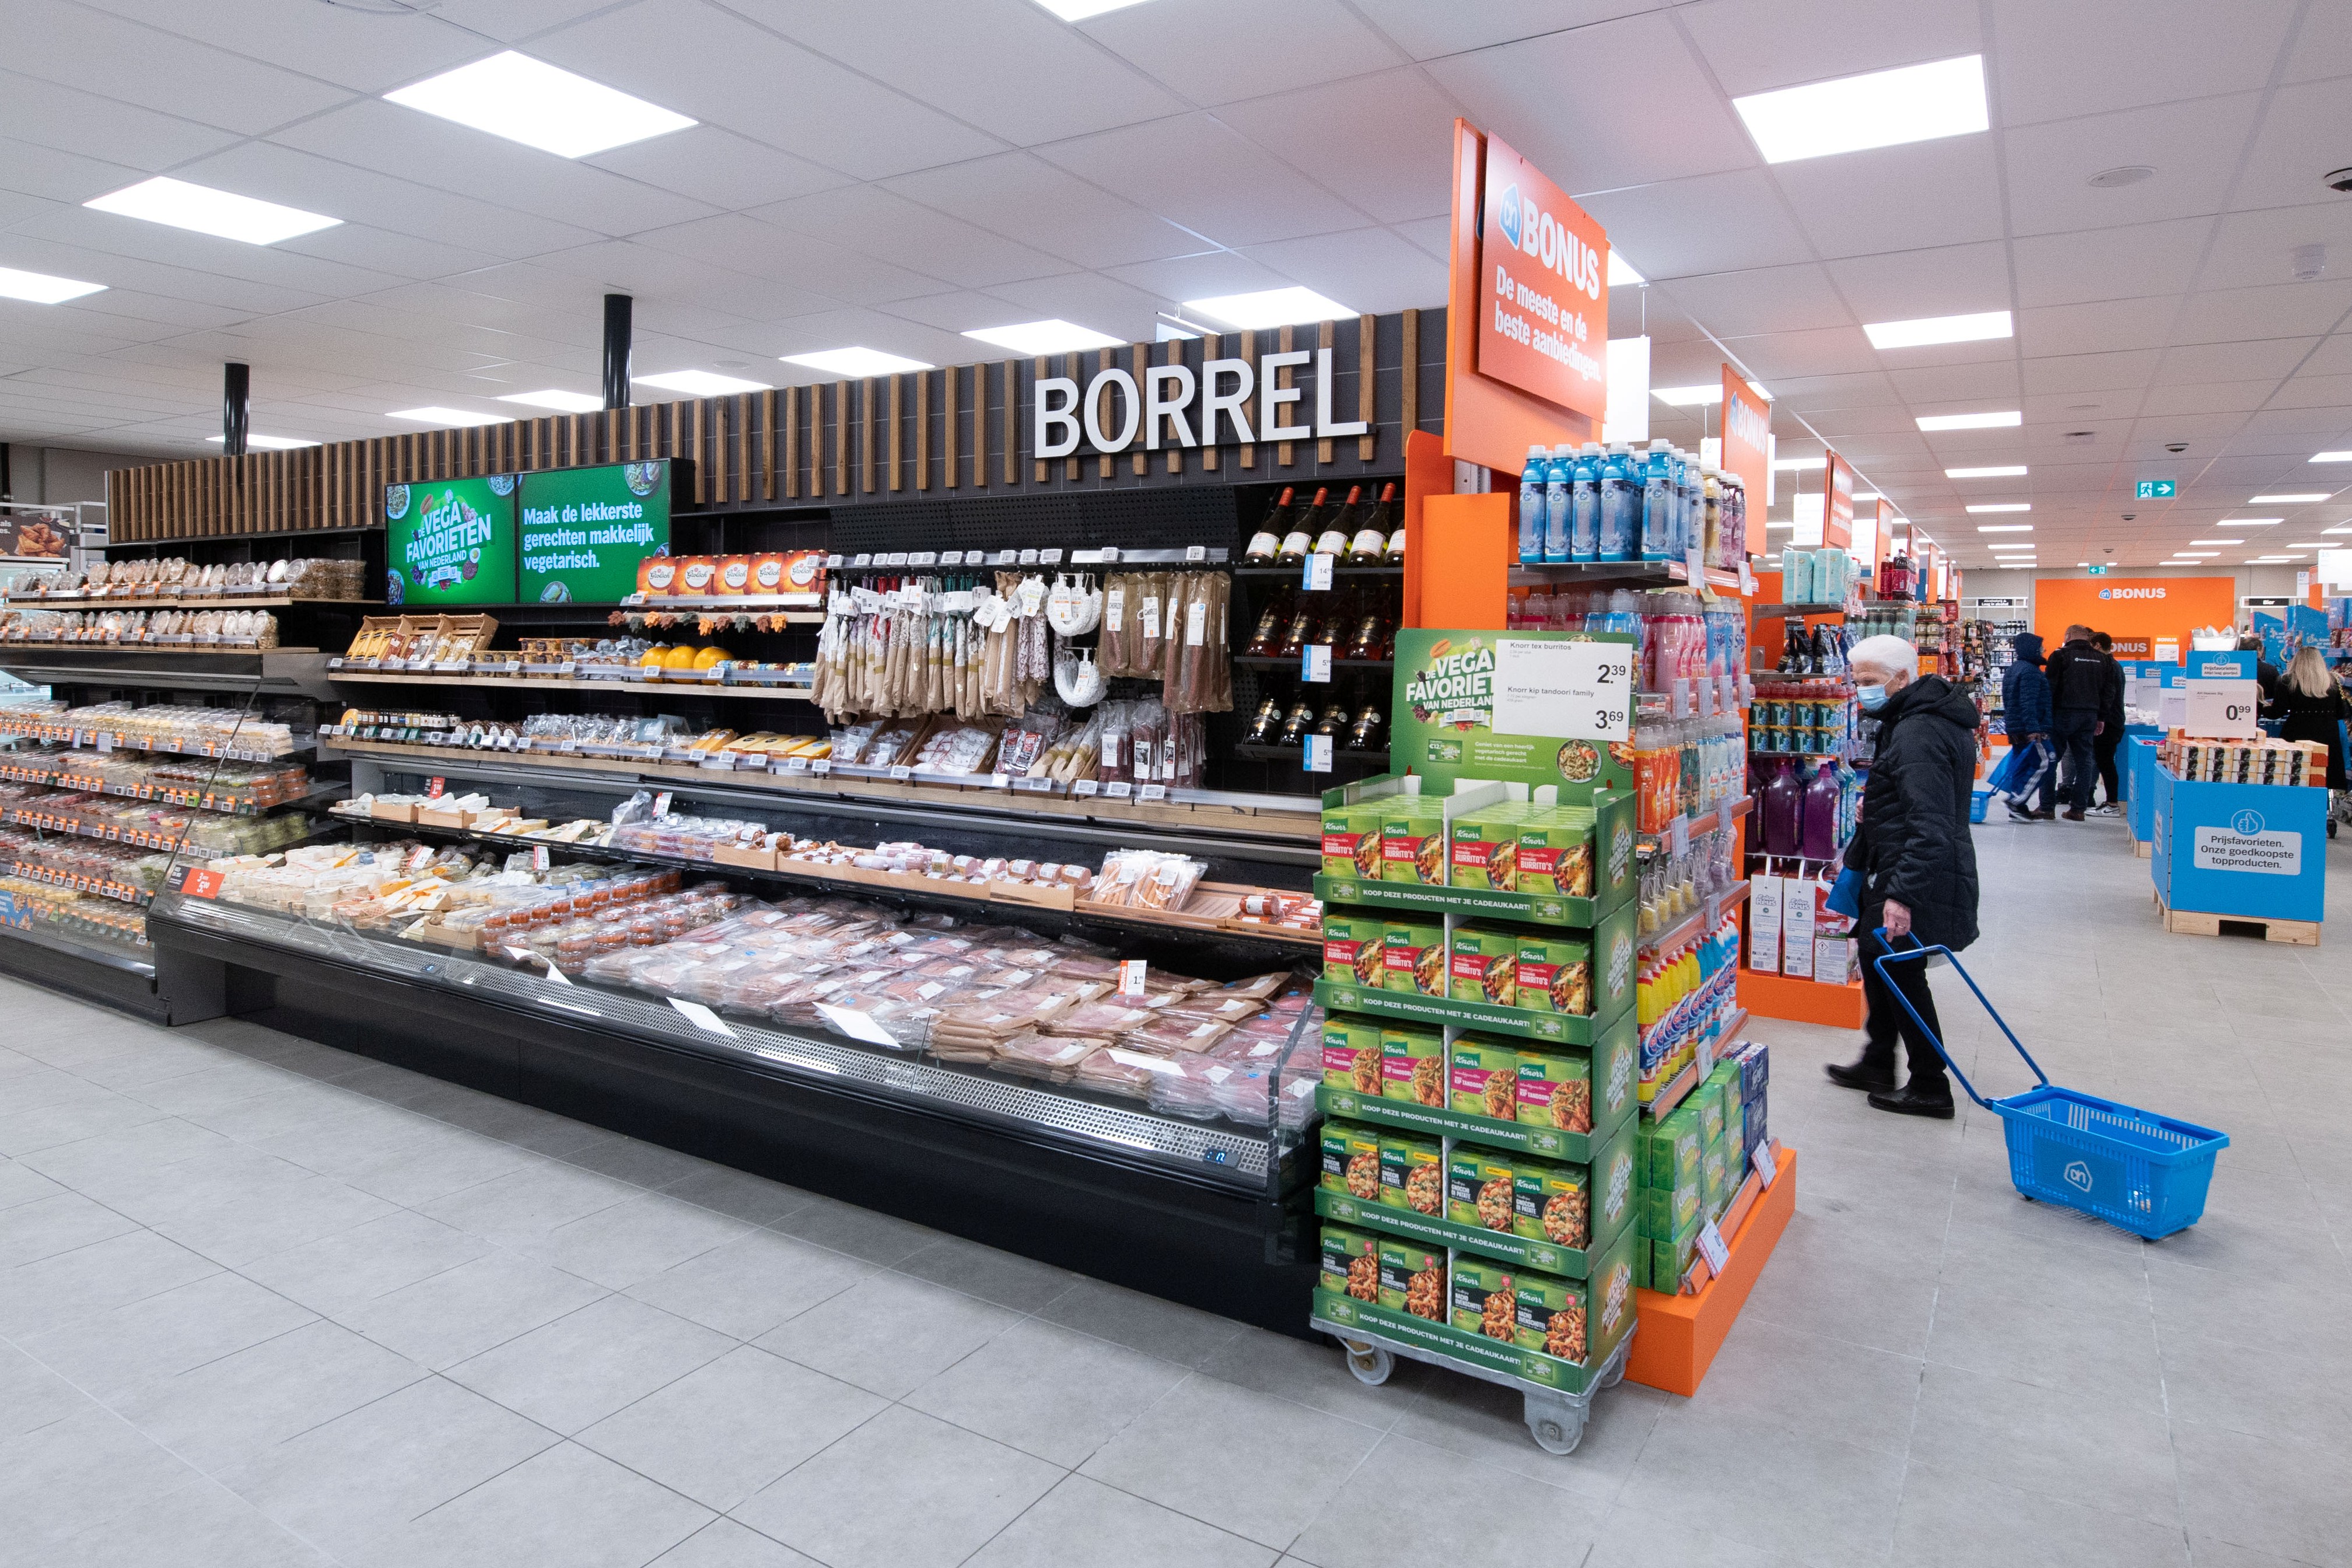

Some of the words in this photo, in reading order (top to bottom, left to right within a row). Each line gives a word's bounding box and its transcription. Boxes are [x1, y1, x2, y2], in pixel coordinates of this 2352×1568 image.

[1522, 197, 1600, 300] BONUS
[1496, 264, 1514, 301] De
[1517, 282, 1559, 326] meeste
[1560, 309, 1573, 335] en
[1575, 312, 1587, 342] de
[1495, 300, 1530, 346] beste
[1532, 328, 1601, 382] aanbiedingen.
[1035, 348, 1367, 459] BORREL
[1738, 398, 1766, 456] BONUS
[524, 506, 559, 524] Maak
[562, 505, 578, 523] de
[581, 502, 642, 522] lekkerste
[418, 528, 425, 538] DE
[424, 501, 461, 534] VEGA
[406, 514, 492, 563] FAVORIETEN
[524, 528, 586, 551] gerechten
[590, 523, 654, 546] makkelijk
[418, 561, 429, 570] VAN
[429, 550, 467, 567] NEDERLAND
[524, 550, 600, 573] vegetarisch.
[2112, 588, 2166, 599] BONUS
[2111, 643, 2147, 652] ONUS
[1426, 670, 1436, 680] DE
[1436, 649, 1493, 678] VEGA
[1597, 664, 1626, 684] 2.39
[1573, 690, 1595, 698] family
[1423, 700, 1439, 710] VAN
[2226, 705, 2251, 720] 0.99
[1595, 710, 1624, 730] 3.69
[1325, 822, 1347, 831] Knorr
[1385, 826, 1408, 834] Knorr
[1456, 830, 1480, 839] Knorr
[1521, 836, 1546, 845] Knorr
[2211, 835, 2284, 848] Prijsfavorieten.
[1325, 846, 1353, 855] BURRITO'S
[1385, 849, 1414, 858] BURRITO'S
[2201, 845, 2226, 855] Onze
[2229, 846, 2294, 859] goedkoopste
[1455, 853, 1486, 864] BURRITO'S
[2212, 857, 2282, 869] topproducten.
[1521, 860, 1552, 871] BURRITO'S
[1403, 892, 1446, 902] PRODUCTEN
[1473, 899, 1531, 911] CADEAUKAART!
[1756, 898, 1777, 906] Reus
[1327, 929, 1350, 938] Knorr
[1386, 935, 1408, 944] Knorr
[1454, 942, 1479, 953] Knorr
[1327, 951, 1352, 960] BURRITO'S
[1520, 950, 1545, 961] Knorr
[1386, 957, 1412, 967] BURRITO'S
[1454, 965, 1481, 976] BURRITO'S
[1520, 974, 1548, 985] BURRITO'S
[1384, 1000, 1402, 1008] DEZE
[1403, 1003, 1446, 1015] PRODUCTEN
[1473, 1013, 1530, 1027] CADEAUKAART!
[1325, 1036, 1346, 1045] Knorr
[1384, 1044, 1406, 1055] Knorr
[1454, 1056, 1479, 1066] Knorr
[1519, 1066, 1545, 1078] Knorr
[1382, 1107, 1400, 1115] DEZE
[1401, 1112, 1443, 1125] PRODUCTEN
[1471, 1125, 1527, 1140] CADEAUKAART!
[1323, 1139, 1344, 1151] Knorr
[1382, 1151, 1405, 1163] Knorr
[1452, 1164, 1476, 1177] Knorr
[1517, 1179, 1541, 1192] Knorr
[1362, 1212, 1380, 1220] KOOP
[1381, 1216, 1399, 1225] DEZE
[1401, 1222, 1441, 1235] PRODUCTEN
[1443, 1231, 1457, 1240] MET
[1469, 1238, 1525, 1255] CADEAUKAART!
[1324, 1239, 1344, 1251] Knorr
[1382, 1254, 1404, 1265] Knorr
[1455, 1273, 1479, 1286] Knorr
[1518, 1291, 1543, 1304] Knorr
[1360, 1314, 1378, 1323] KOOP
[1379, 1319, 1396, 1329] DEZE
[1398, 1324, 1438, 1342] PRODUCTEN
[1440, 1336, 1454, 1345] MET
[1465, 1344, 1521, 1365] CADEAUKAART!
